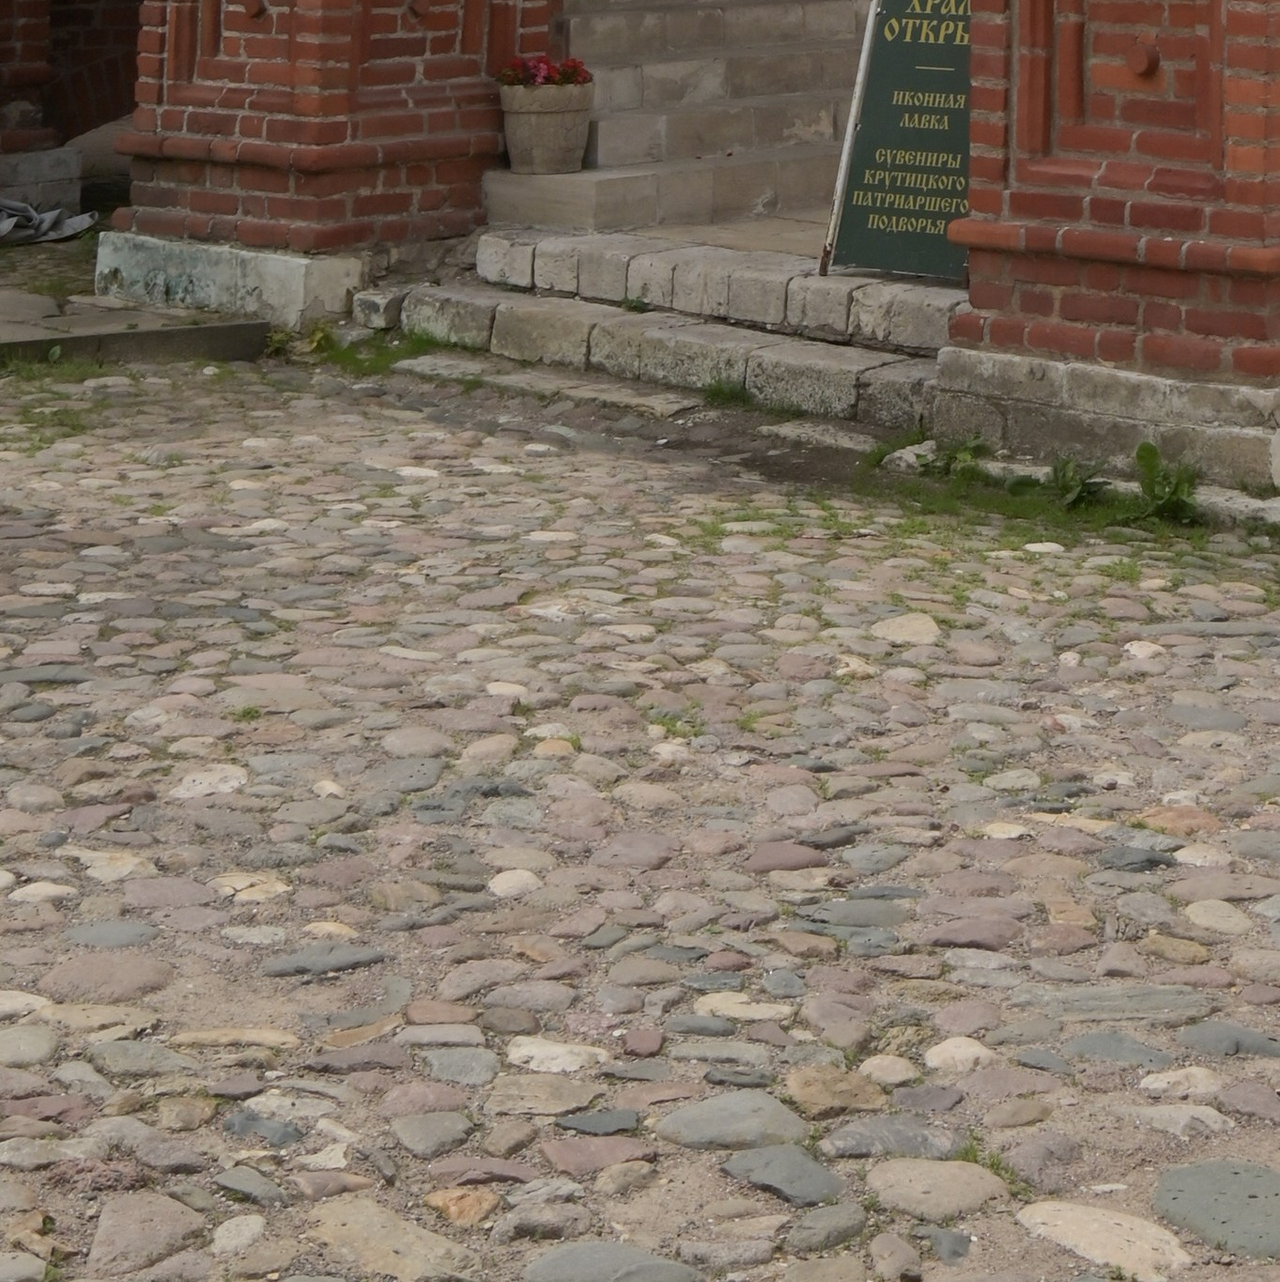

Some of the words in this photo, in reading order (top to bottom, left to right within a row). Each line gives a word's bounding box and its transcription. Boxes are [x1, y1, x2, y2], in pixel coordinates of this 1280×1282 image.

[891, 90, 966, 109] ИКОННАЯ
[900, 113, 949, 130] ЛАВКА
[875, 148, 962, 169] СУВЕНИРЫ
[863, 169, 966, 193] КРУТИЦКОГО
[851, 190, 969, 214] ПАТРИАРШЕГО
[867, 214, 946, 235] ПОДВОРЬЯ
